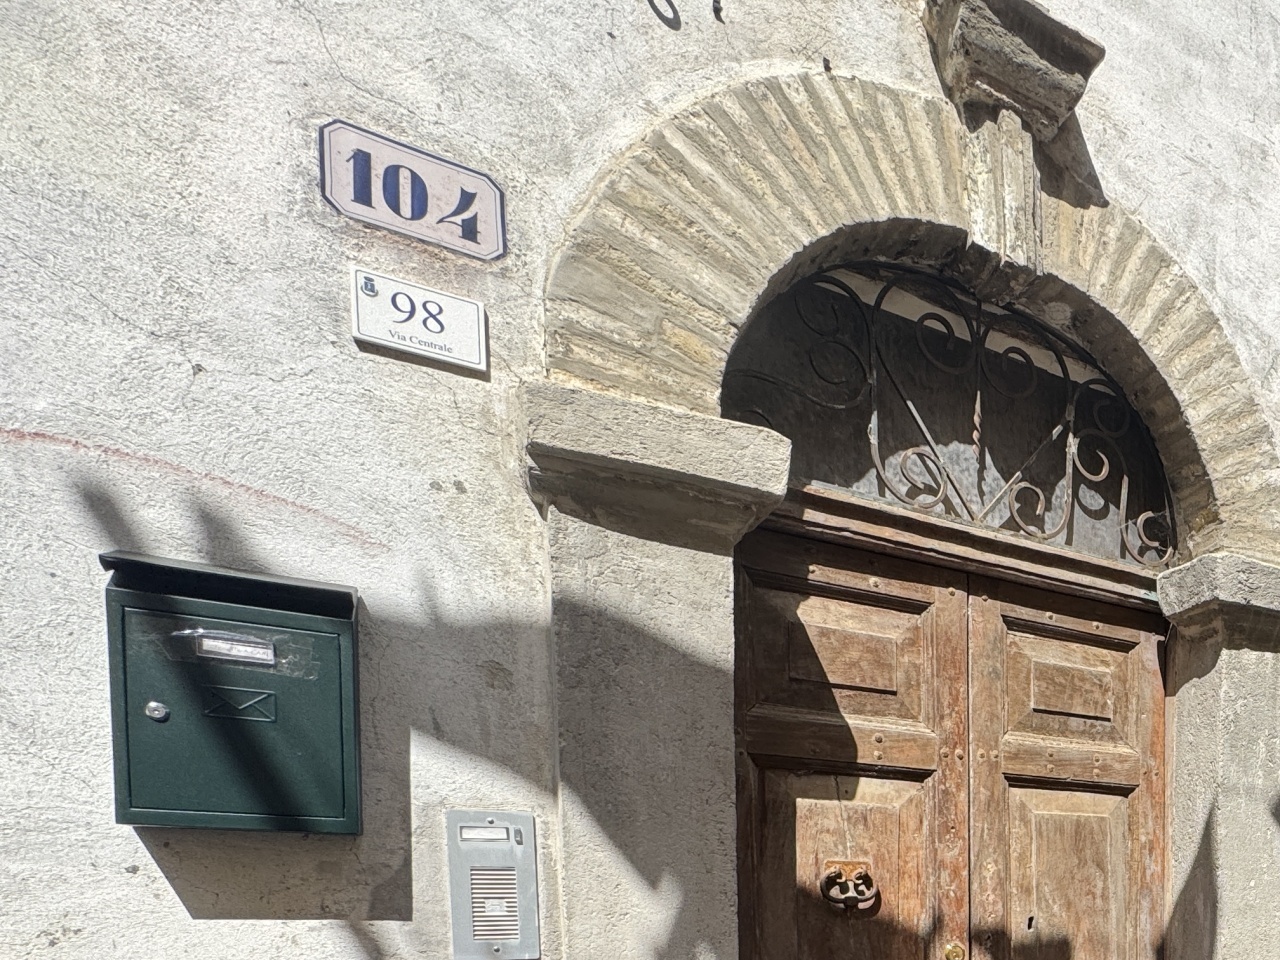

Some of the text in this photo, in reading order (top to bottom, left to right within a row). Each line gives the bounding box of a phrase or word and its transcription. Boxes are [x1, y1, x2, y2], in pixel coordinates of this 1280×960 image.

[345, 148, 482, 245] 104
[390, 291, 446, 335] 98
[388, 329, 453, 354] Via Centrale
